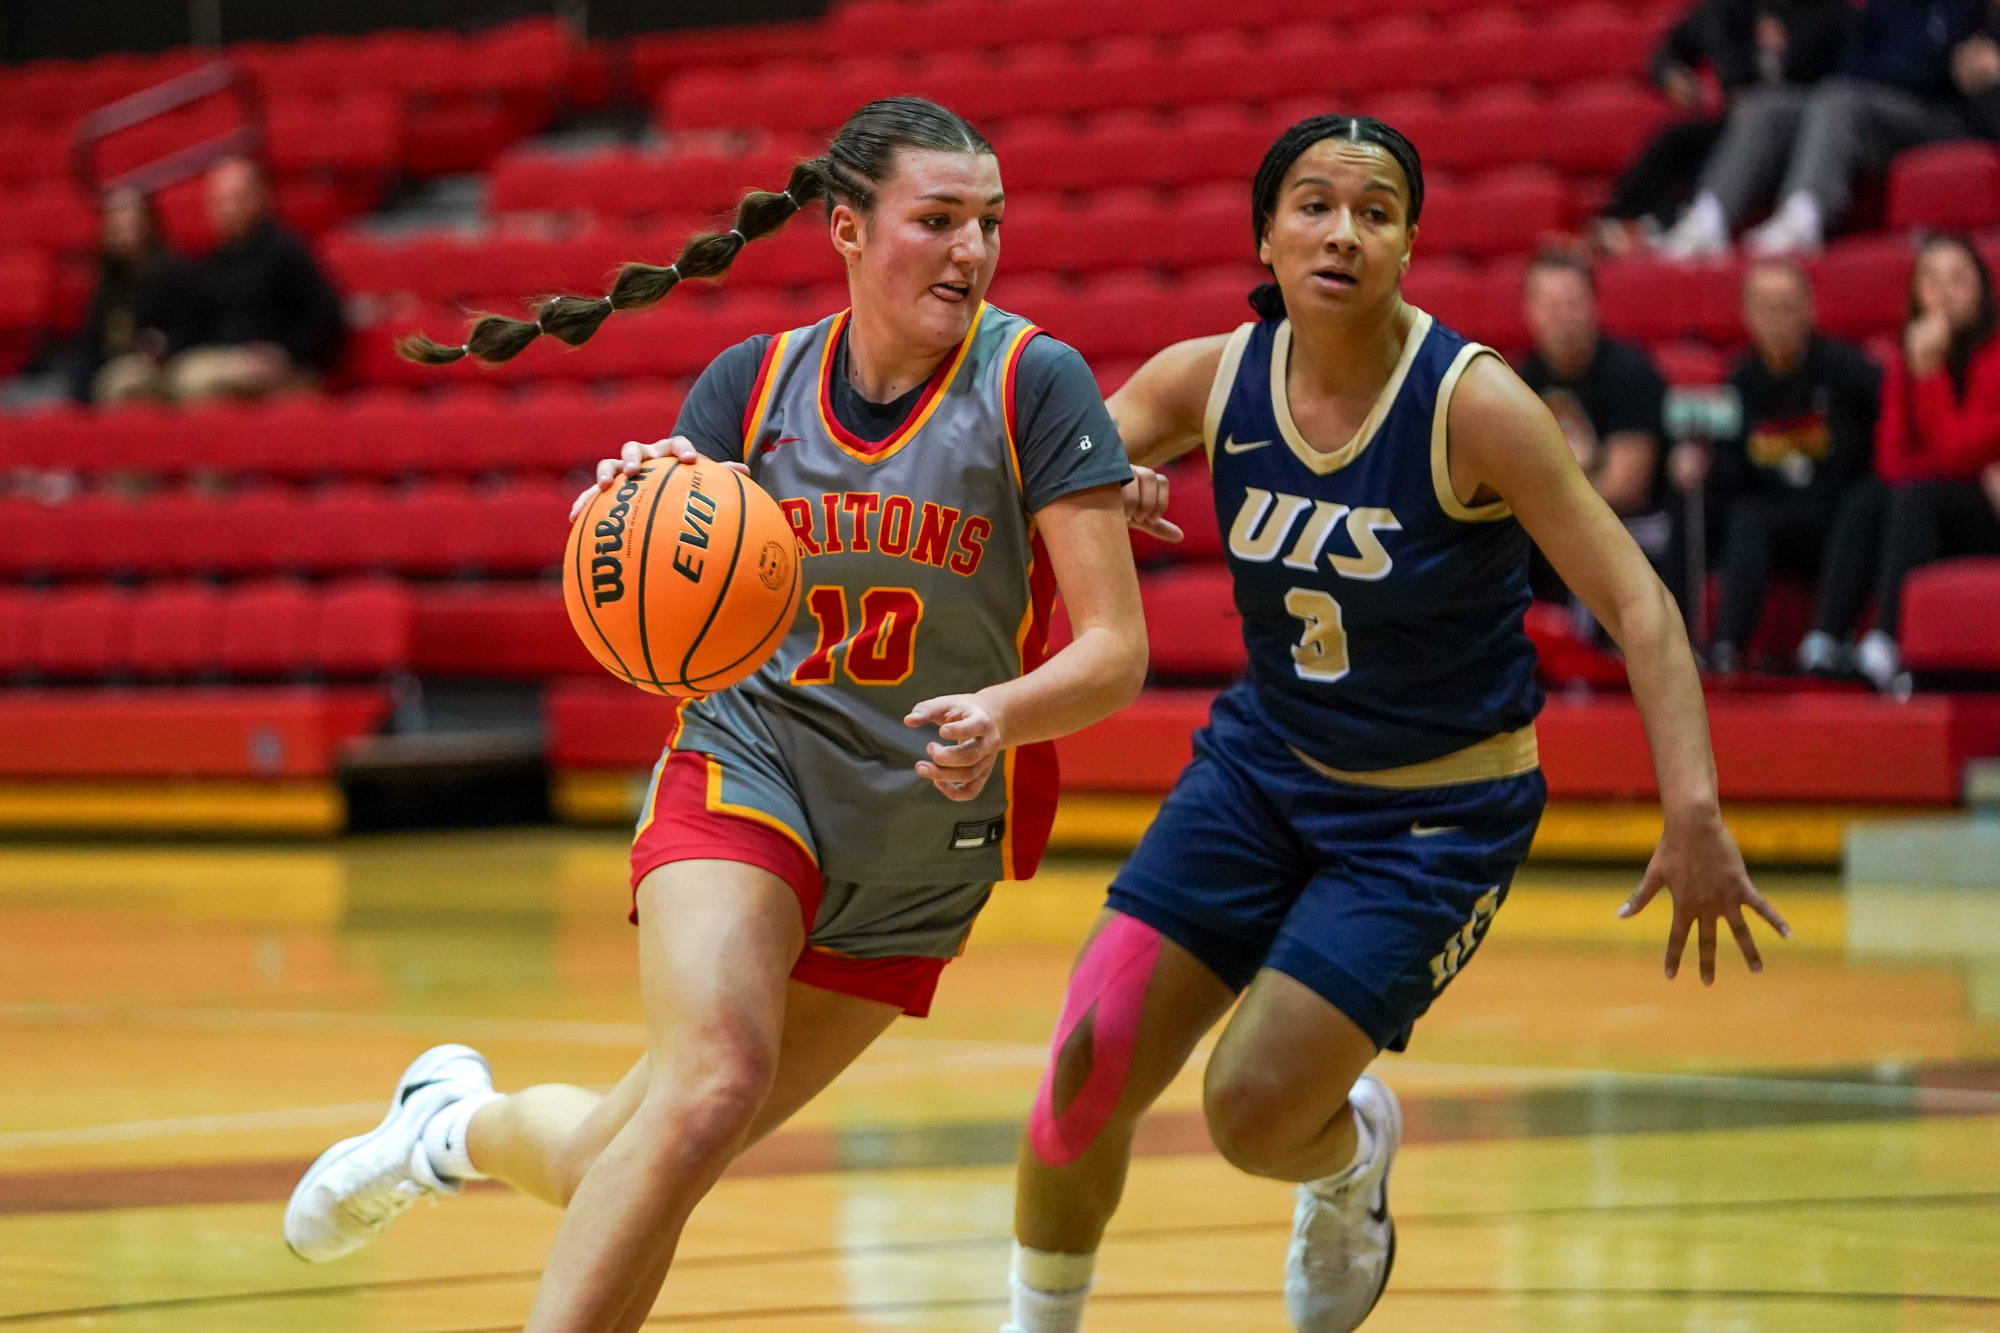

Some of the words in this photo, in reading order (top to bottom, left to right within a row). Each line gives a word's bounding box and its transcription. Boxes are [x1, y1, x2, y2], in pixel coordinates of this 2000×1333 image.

[673, 489, 717, 584] EVO
[779, 491, 993, 578] RITONS
[1228, 486, 1404, 583] UIS
[790, 585, 924, 686] 10
[1284, 586, 1350, 684] 3
